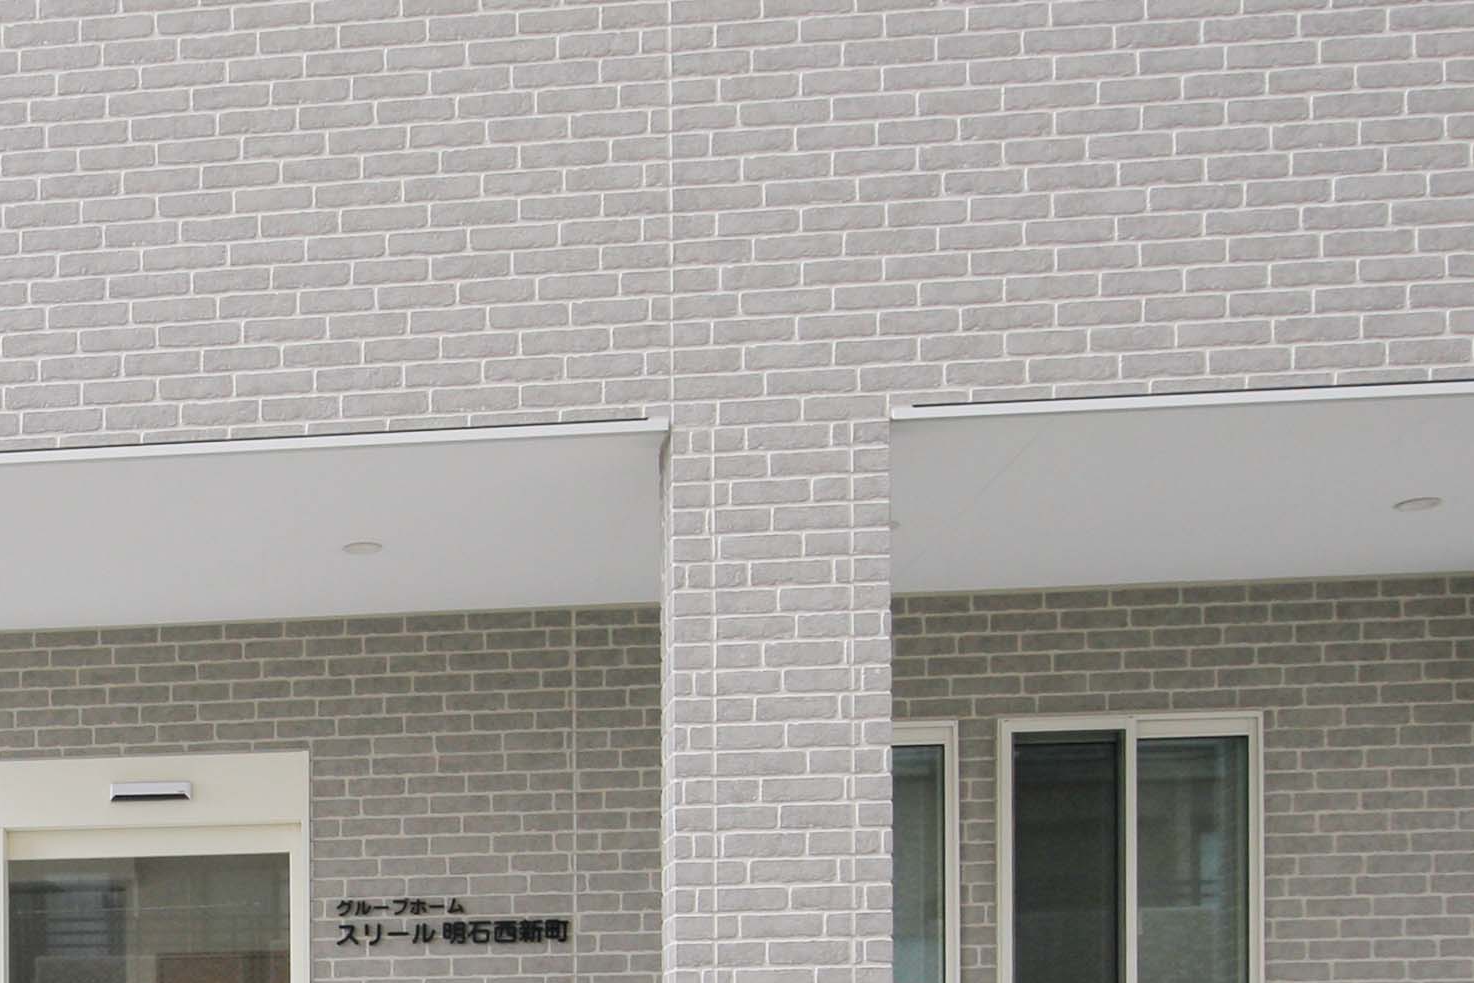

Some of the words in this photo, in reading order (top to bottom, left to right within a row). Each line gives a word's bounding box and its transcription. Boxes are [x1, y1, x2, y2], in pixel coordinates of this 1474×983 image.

[336, 898, 465, 916] グループホーム
[337, 924, 436, 946] スリール
[442, 919, 569, 945] 明石西新町
